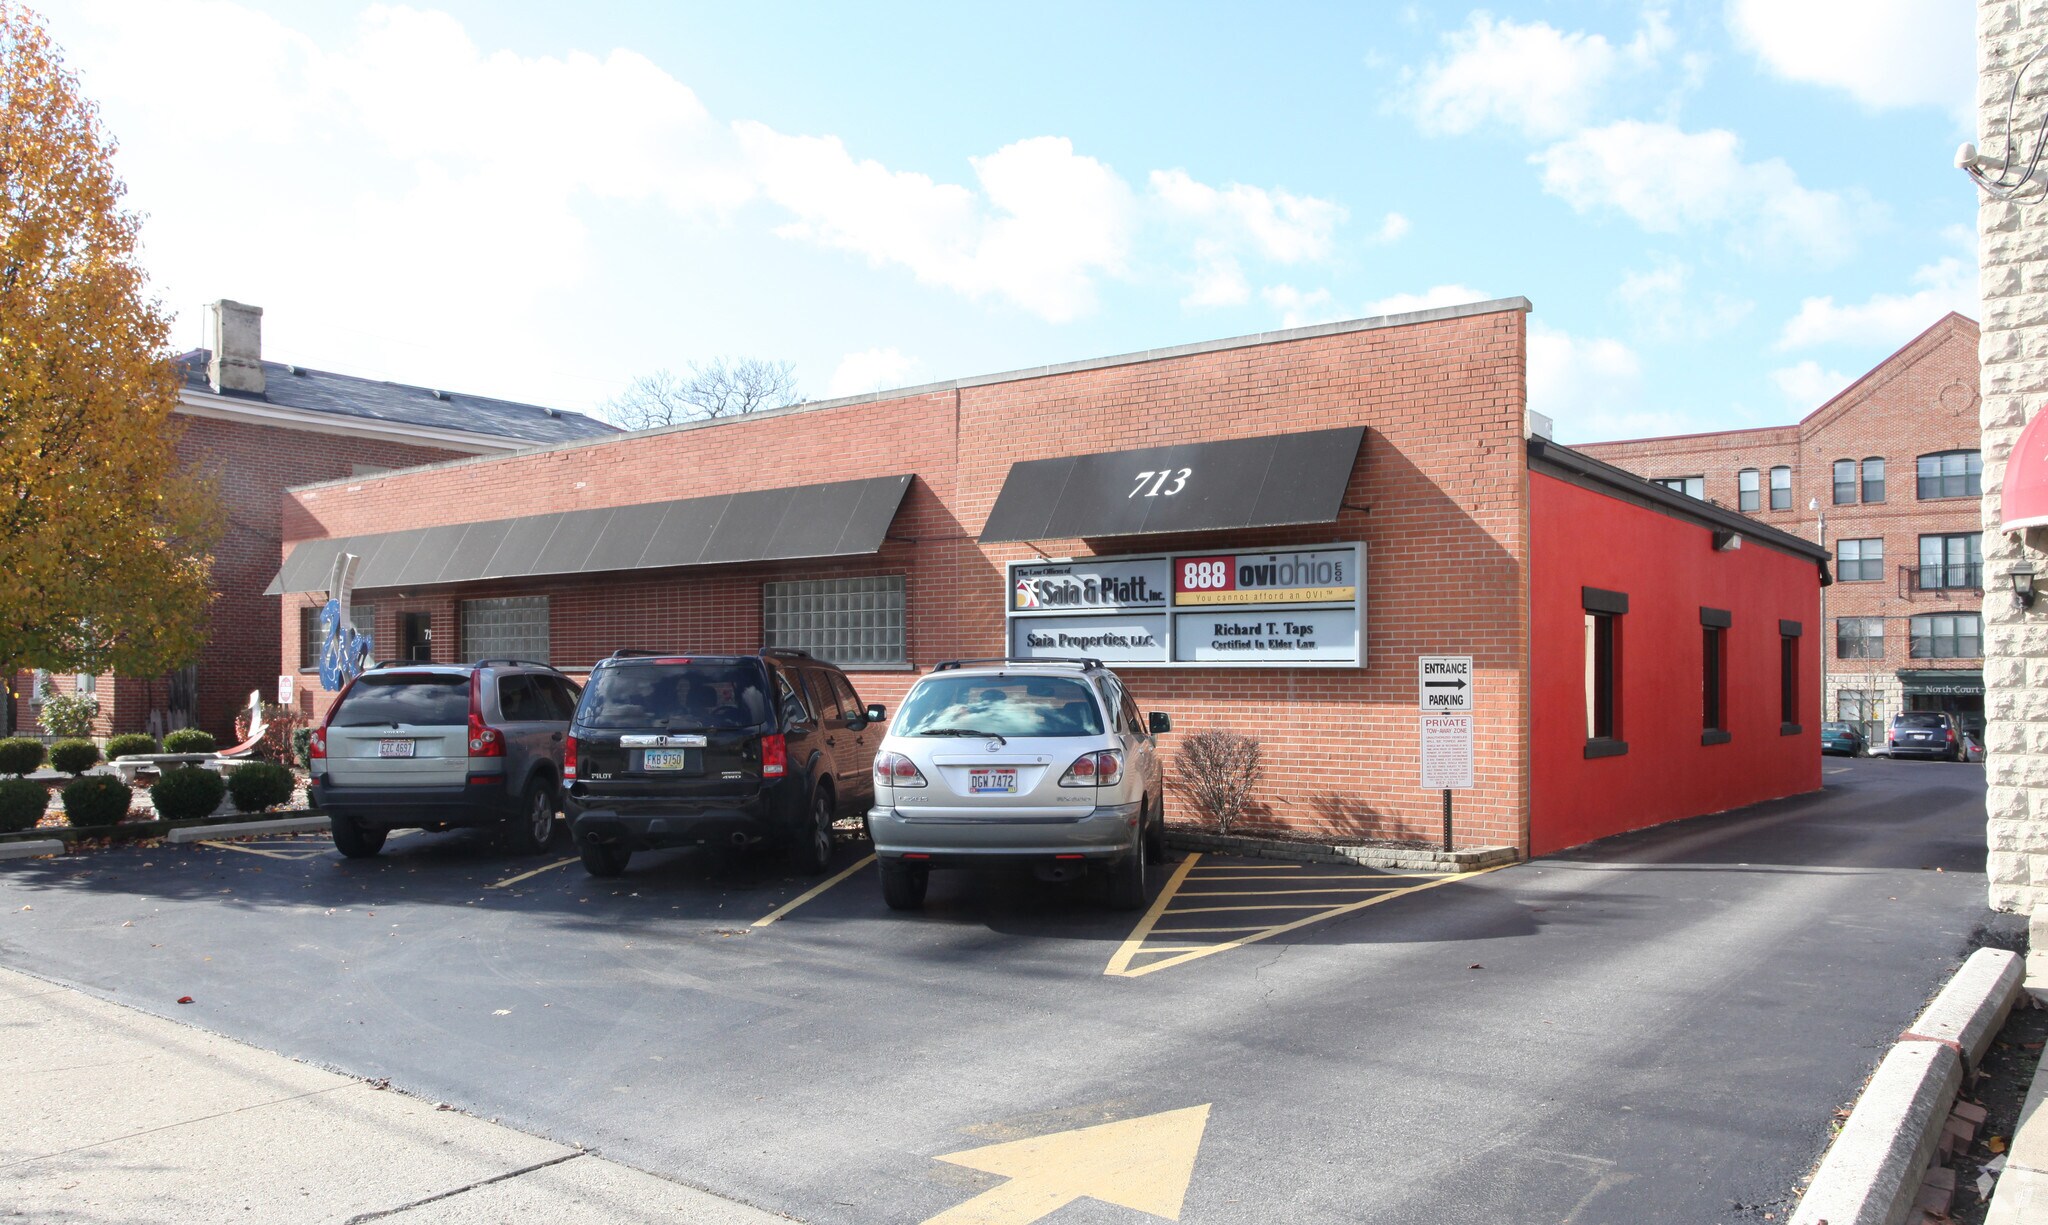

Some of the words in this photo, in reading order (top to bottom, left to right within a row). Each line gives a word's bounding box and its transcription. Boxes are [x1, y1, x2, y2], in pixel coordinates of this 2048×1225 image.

[1128, 467, 1192, 499] 713
[1017, 569, 1029, 577] The
[1029, 568, 1042, 576] Law
[1064, 566, 1071, 574] of
[1184, 561, 1226, 589] 888
[1042, 579, 1080, 605] Saia
[1083, 578, 1098, 604] &
[1149, 589, 1165, 601] Inc.
[1196, 594, 1212, 602] You
[1217, 593, 1248, 602] cannot
[1254, 592, 1284, 600] afford
[1289, 592, 1300, 600] an
[1214, 622, 1262, 636] Richard
[1266, 622, 1279, 635] T.
[1283, 622, 1314, 637] Taps
[1027, 633, 1055, 648] Saia
[1058, 632, 1130, 651] Properties,
[1211, 639, 1252, 650] Certified
[1255, 639, 1265, 649] In
[1268, 639, 1293, 649] Elder
[1296, 639, 1316, 649] Law
[1425, 663, 1467, 674] ENTRANCE
[1926, 685, 1952, 693] North
[1954, 685, 1980, 694] Court
[1429, 694, 1464, 706] PARKING
[1426, 719, 1467, 727] PRIVATE
[663, 754, 681, 765] 9750
[971, 775, 988, 788] DGW
[991, 775, 1014, 788] 7472
